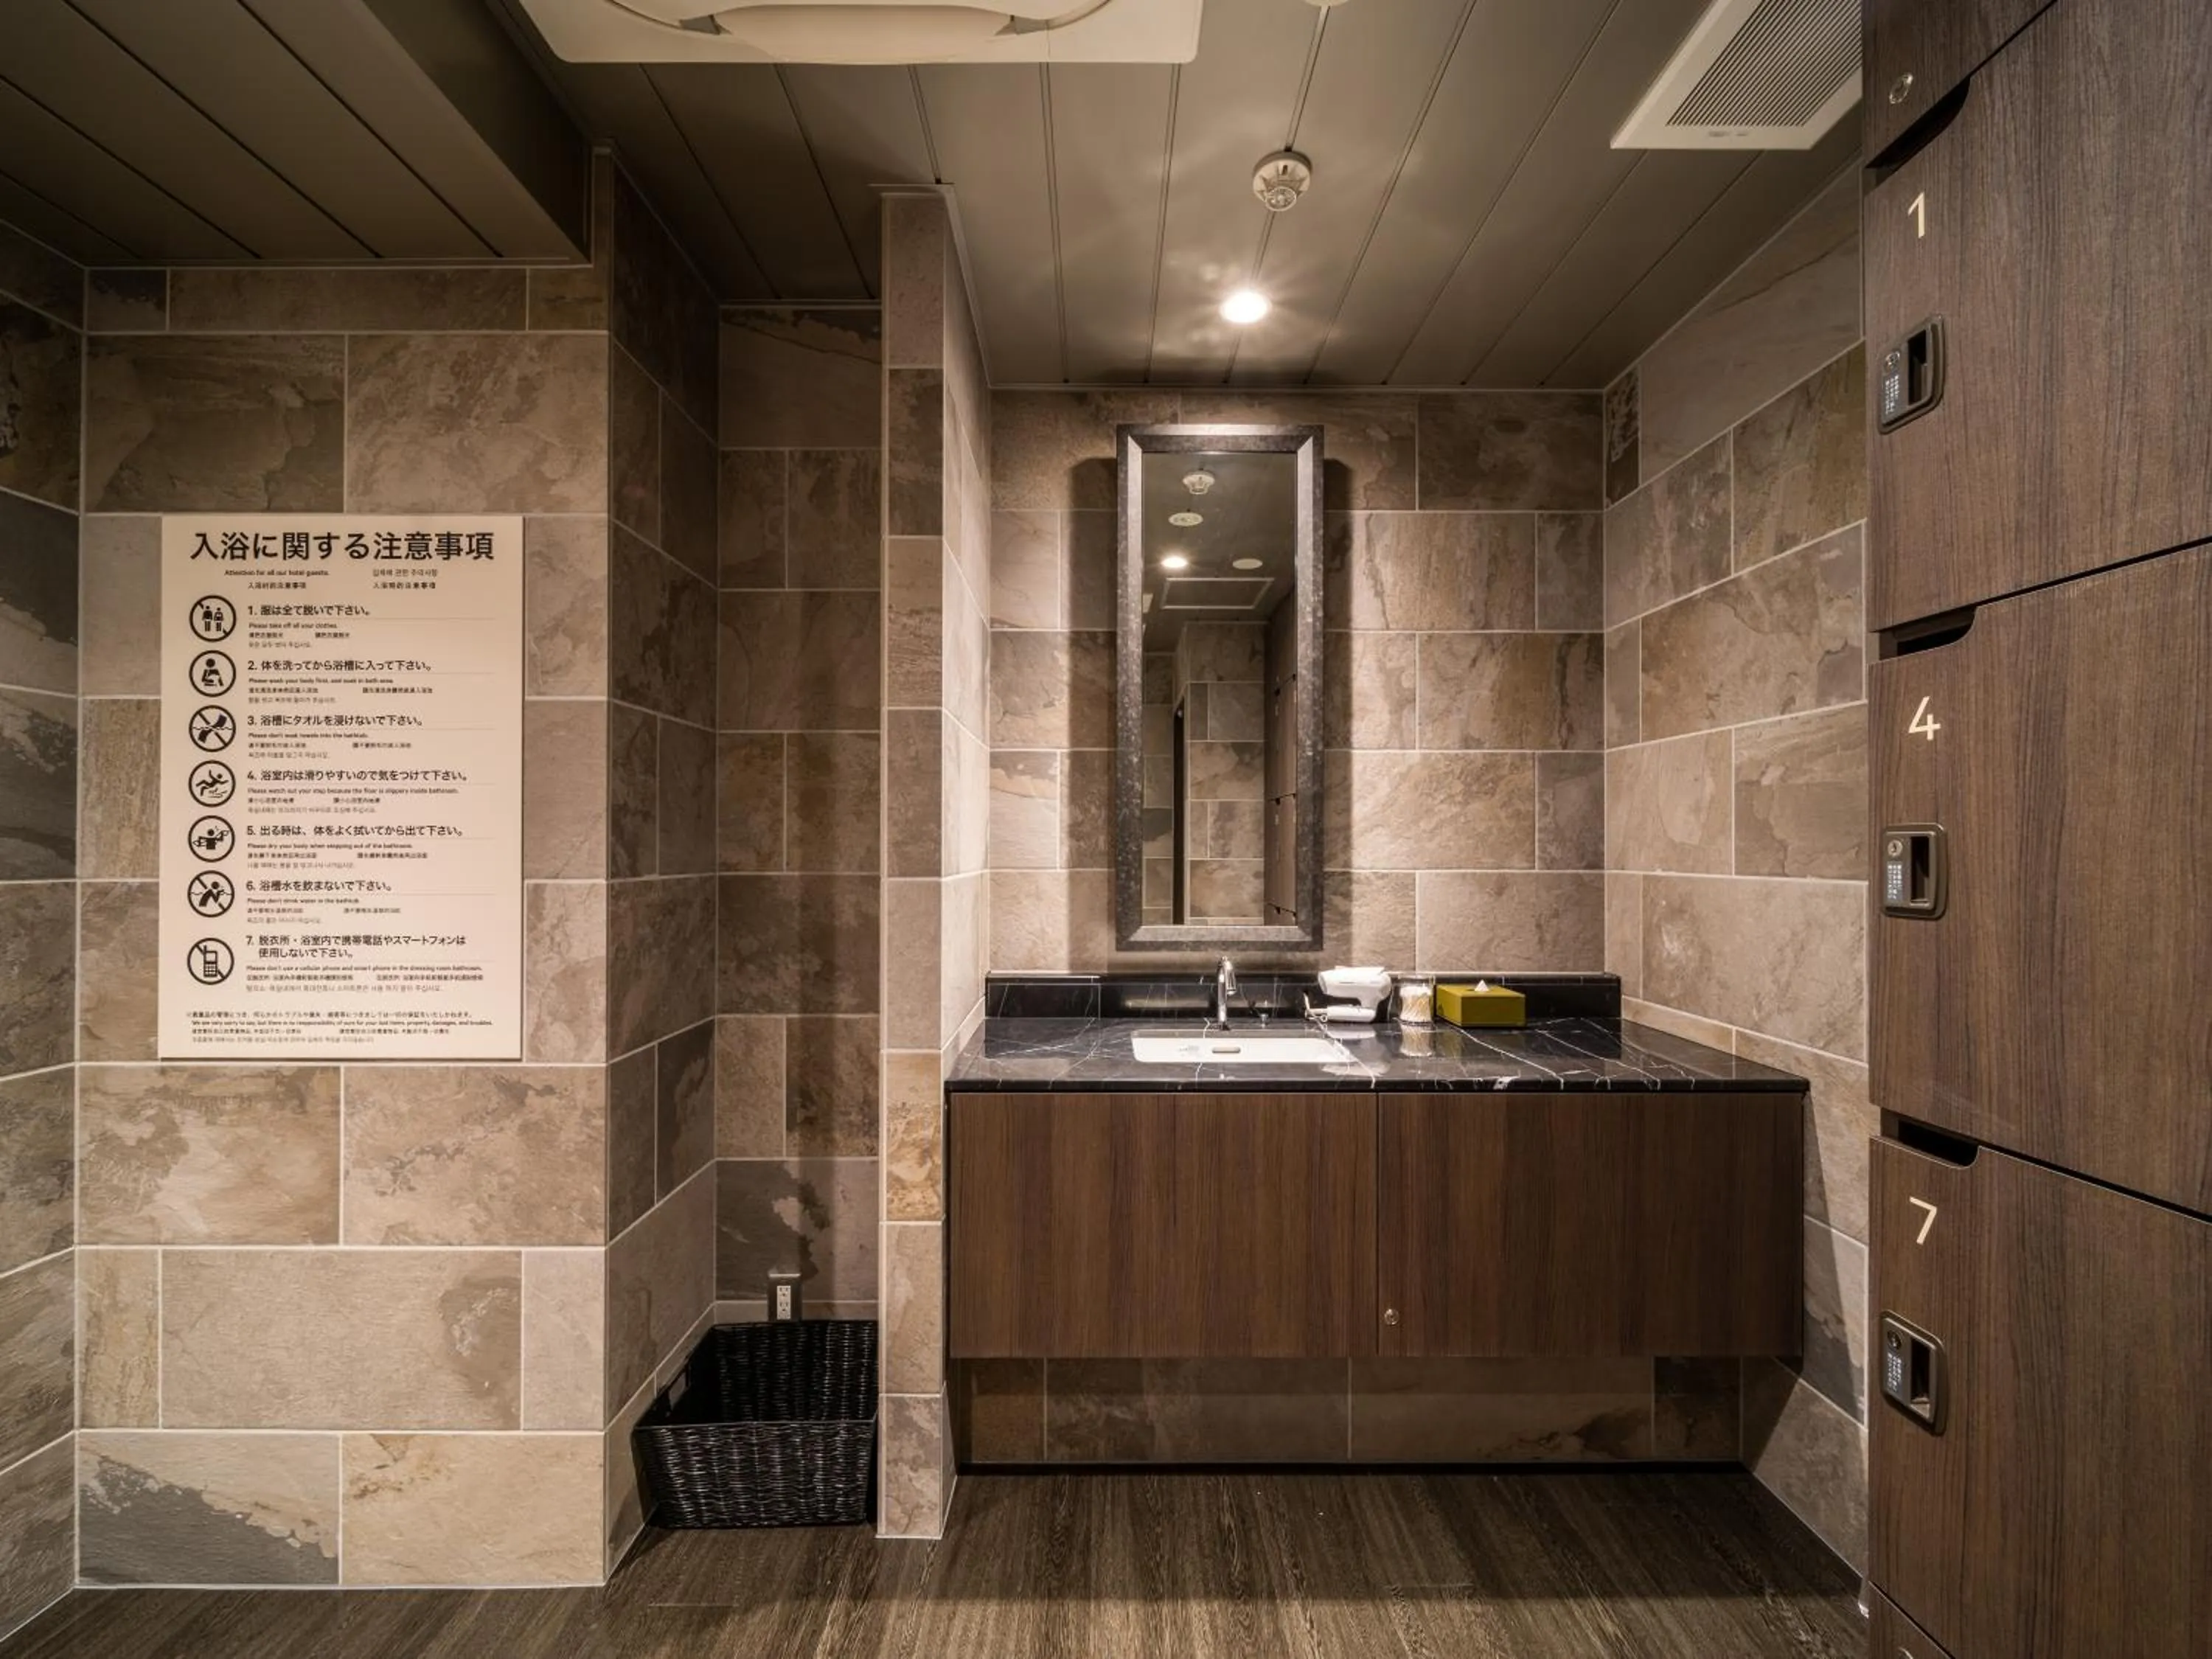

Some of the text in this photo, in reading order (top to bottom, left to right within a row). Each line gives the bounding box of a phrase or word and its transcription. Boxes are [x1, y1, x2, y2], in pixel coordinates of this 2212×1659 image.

[1907, 192, 1925, 238] 1
[190, 532, 494, 560] 入浴に関する注意事項
[248, 605, 370, 616] 1. 服は全て脱いで下さい。
[248, 661, 431, 670] 2. 体を洗ってから浴槽に入って下さい。
[248, 715, 257, 726] 3.
[1908, 696, 1941, 740] 4
[247, 770, 467, 781] 4. 浴室内は滑りやすいので気をつけて下さい。
[247, 825, 256, 835] 5.
[246, 880, 256, 891] 6.
[246, 935, 466, 946] 7. 脱衣所・浴室内で携帯電話やスマートフォンは
[259, 947, 353, 959] 使用しないで下さい。
[1909, 1196, 1938, 1245] 7
